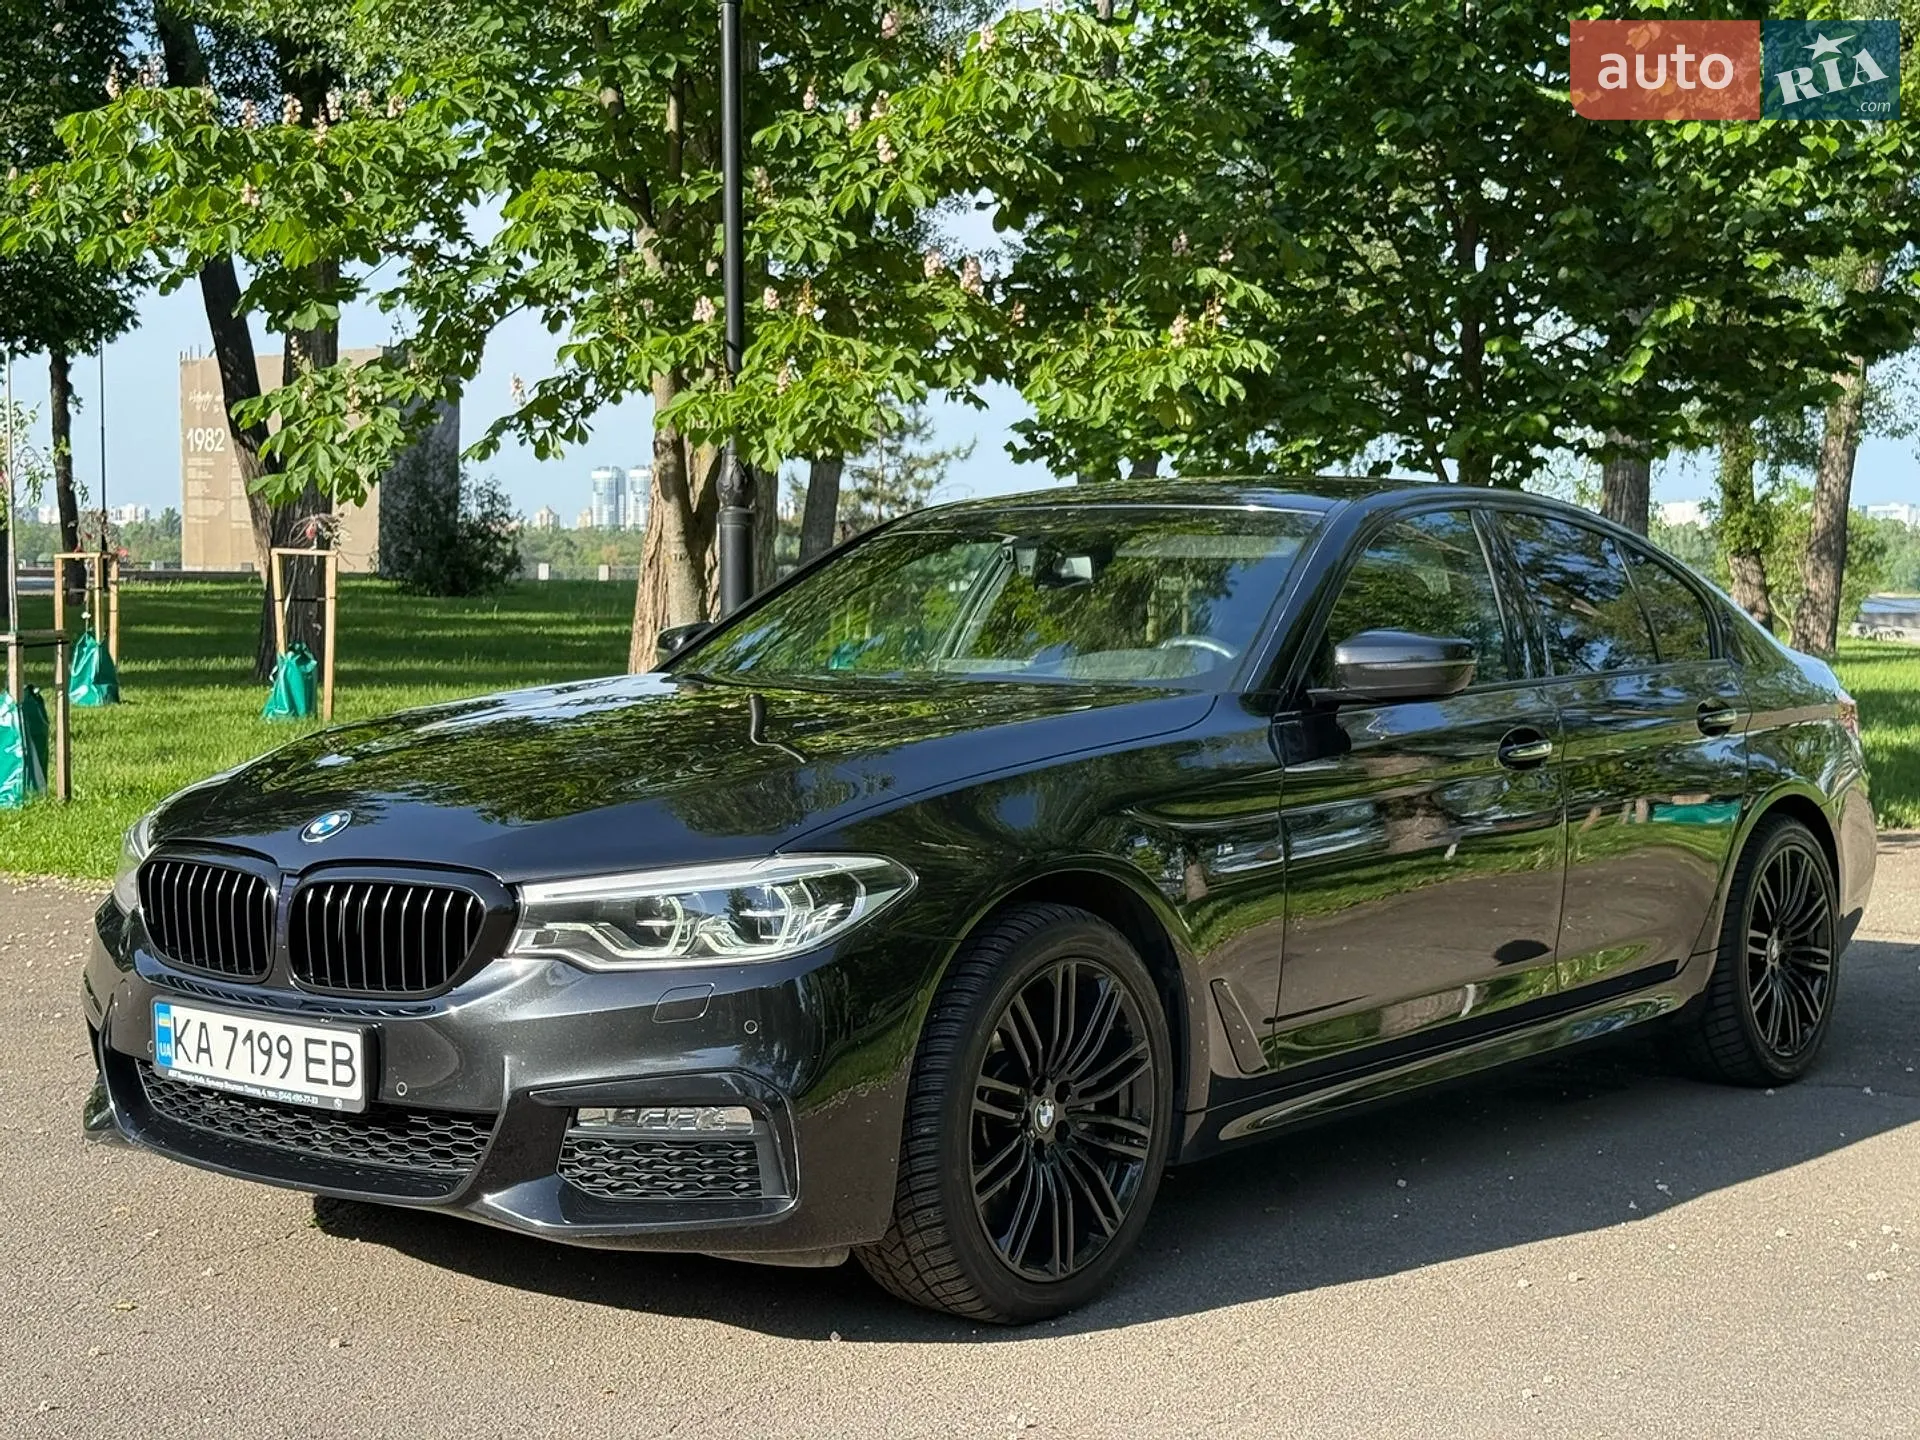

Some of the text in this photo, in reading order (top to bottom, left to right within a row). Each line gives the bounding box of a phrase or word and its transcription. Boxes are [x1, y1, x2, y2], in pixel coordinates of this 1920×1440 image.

[186, 427, 226, 453] 1982
[159, 1042, 171, 1057] UA
[173, 1016, 213, 1068] KA
[223, 1025, 292, 1079] 7199
[304, 1038, 356, 1088] EB
